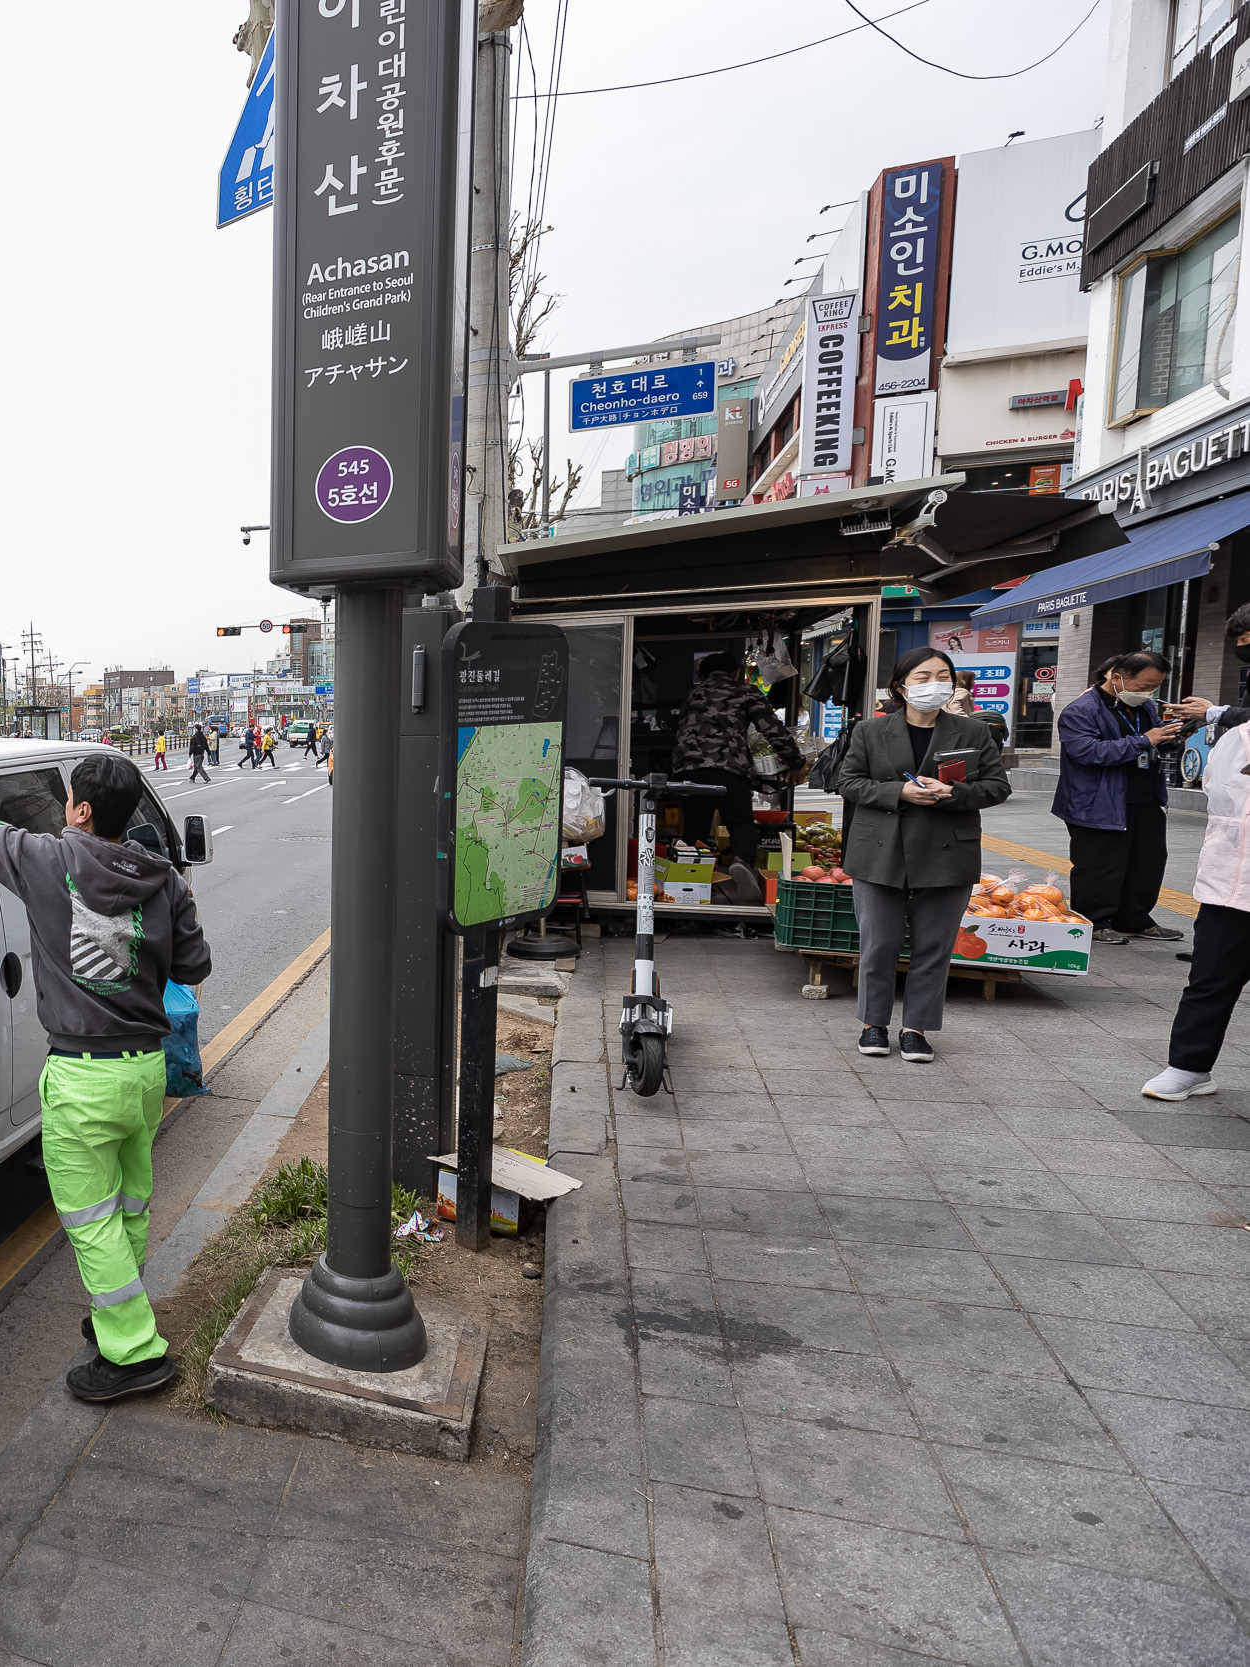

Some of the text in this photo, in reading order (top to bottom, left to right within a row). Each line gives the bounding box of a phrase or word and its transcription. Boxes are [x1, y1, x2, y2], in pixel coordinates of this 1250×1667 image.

[306, 250, 410, 285] Achasan
[885, 170, 929, 349] 미소인 치과
[1019, 265, 1063, 278] Eddie's
[302, 273, 414, 306] (Rear Entrance to Seoul
[303, 289, 412, 320] Children's Grand Park)
[818, 300, 849, 312] COFFEE
[823, 308, 844, 318] KING
[321, 319, 391, 351] 峨嵯山
[817, 321, 849, 332] EXPRESS
[304, 356, 409, 388] アチャサン
[698, 368, 703, 376] 1
[591, 374, 669, 399] 천호대로
[878, 377, 927, 392] 456-2204
[580, 392, 680, 413] Cheonho-daero
[692, 391, 708, 401] 659
[813, 334, 845, 468] COFFEEKING
[724, 406, 744, 421] kt
[664, 433, 717, 463] 정형외
[985, 438, 1018, 446] CHICKEN
[1027, 434, 1058, 442] BURGER
[337, 459, 370, 478] 545
[327, 481, 379, 508] 5호선
[1082, 473, 1132, 502] PARIS
[1037, 591, 1088, 613] PARIS BAGUETTE
[262, 622, 271, 630] 50
[459, 669, 500, 683] 광진둘레길
[984, 669, 1006, 677] 조제
[1007, 938, 1050, 954] 사과
